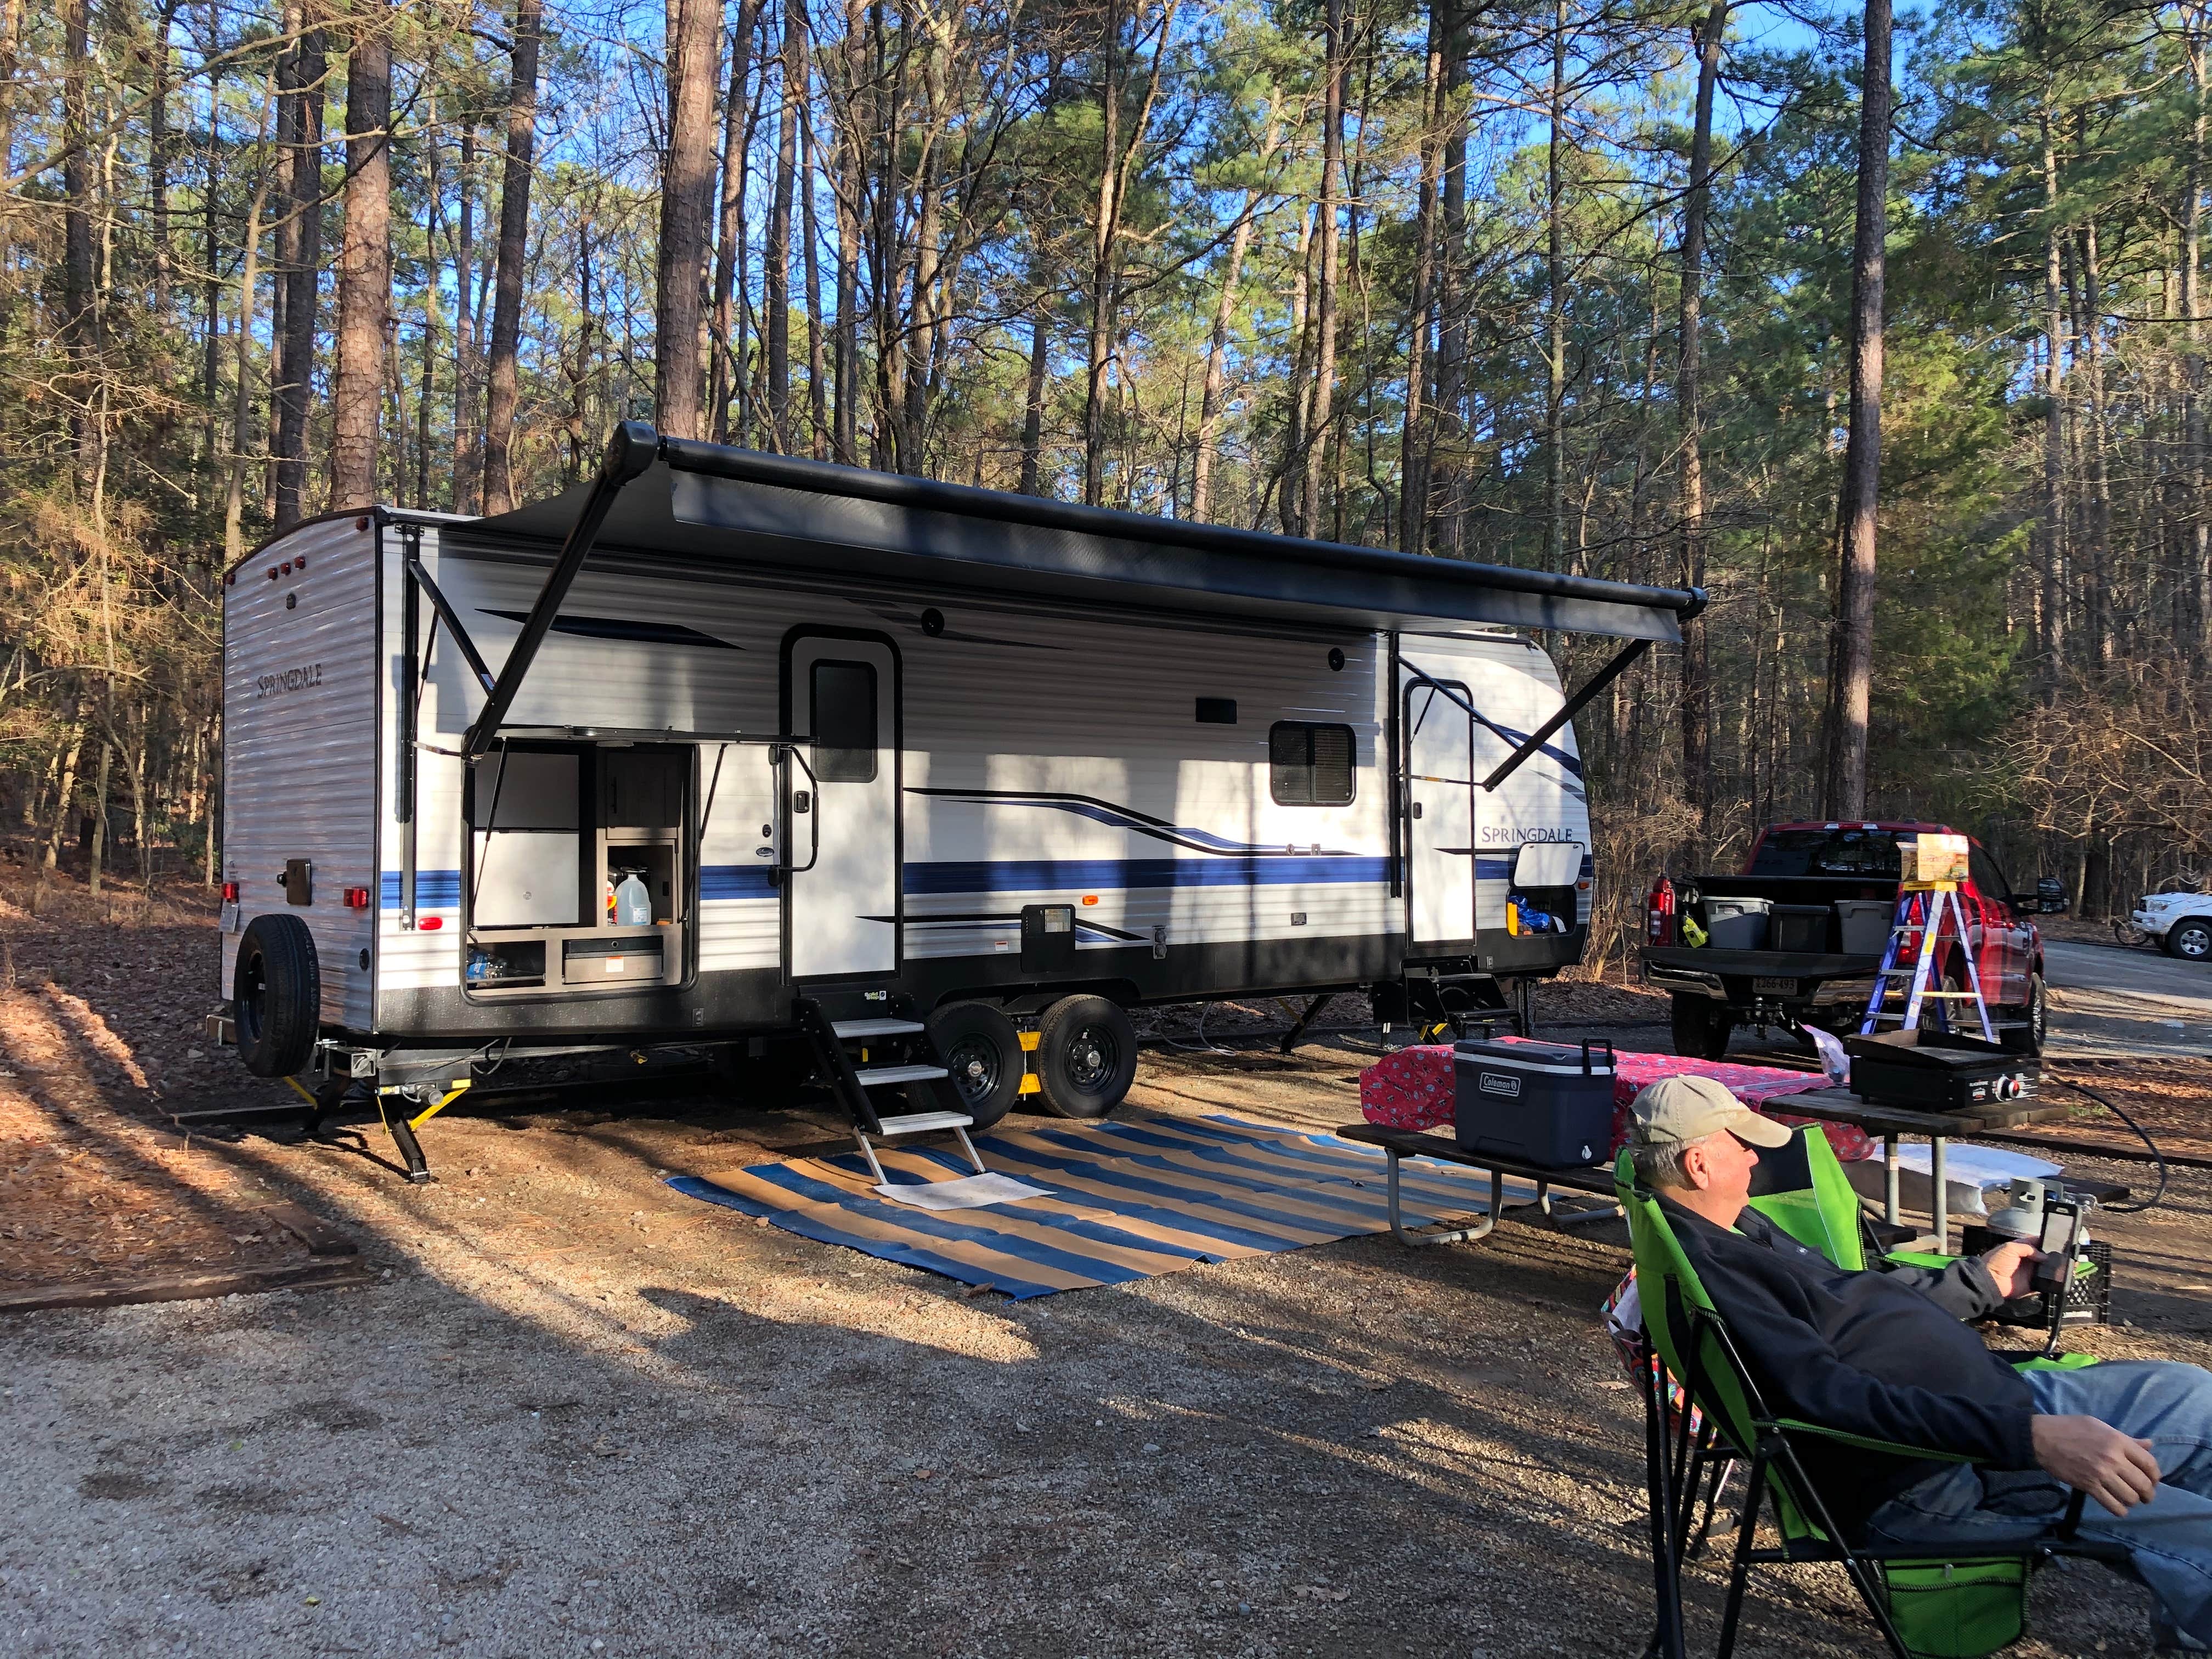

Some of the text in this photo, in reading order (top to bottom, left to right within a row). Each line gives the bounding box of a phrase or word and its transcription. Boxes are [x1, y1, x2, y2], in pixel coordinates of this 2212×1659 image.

[257, 663, 322, 698] SPRINGDALE
[1481, 826, 1573, 843] SPRINGDALE
[1483, 1075, 1510, 1089] Coleman
